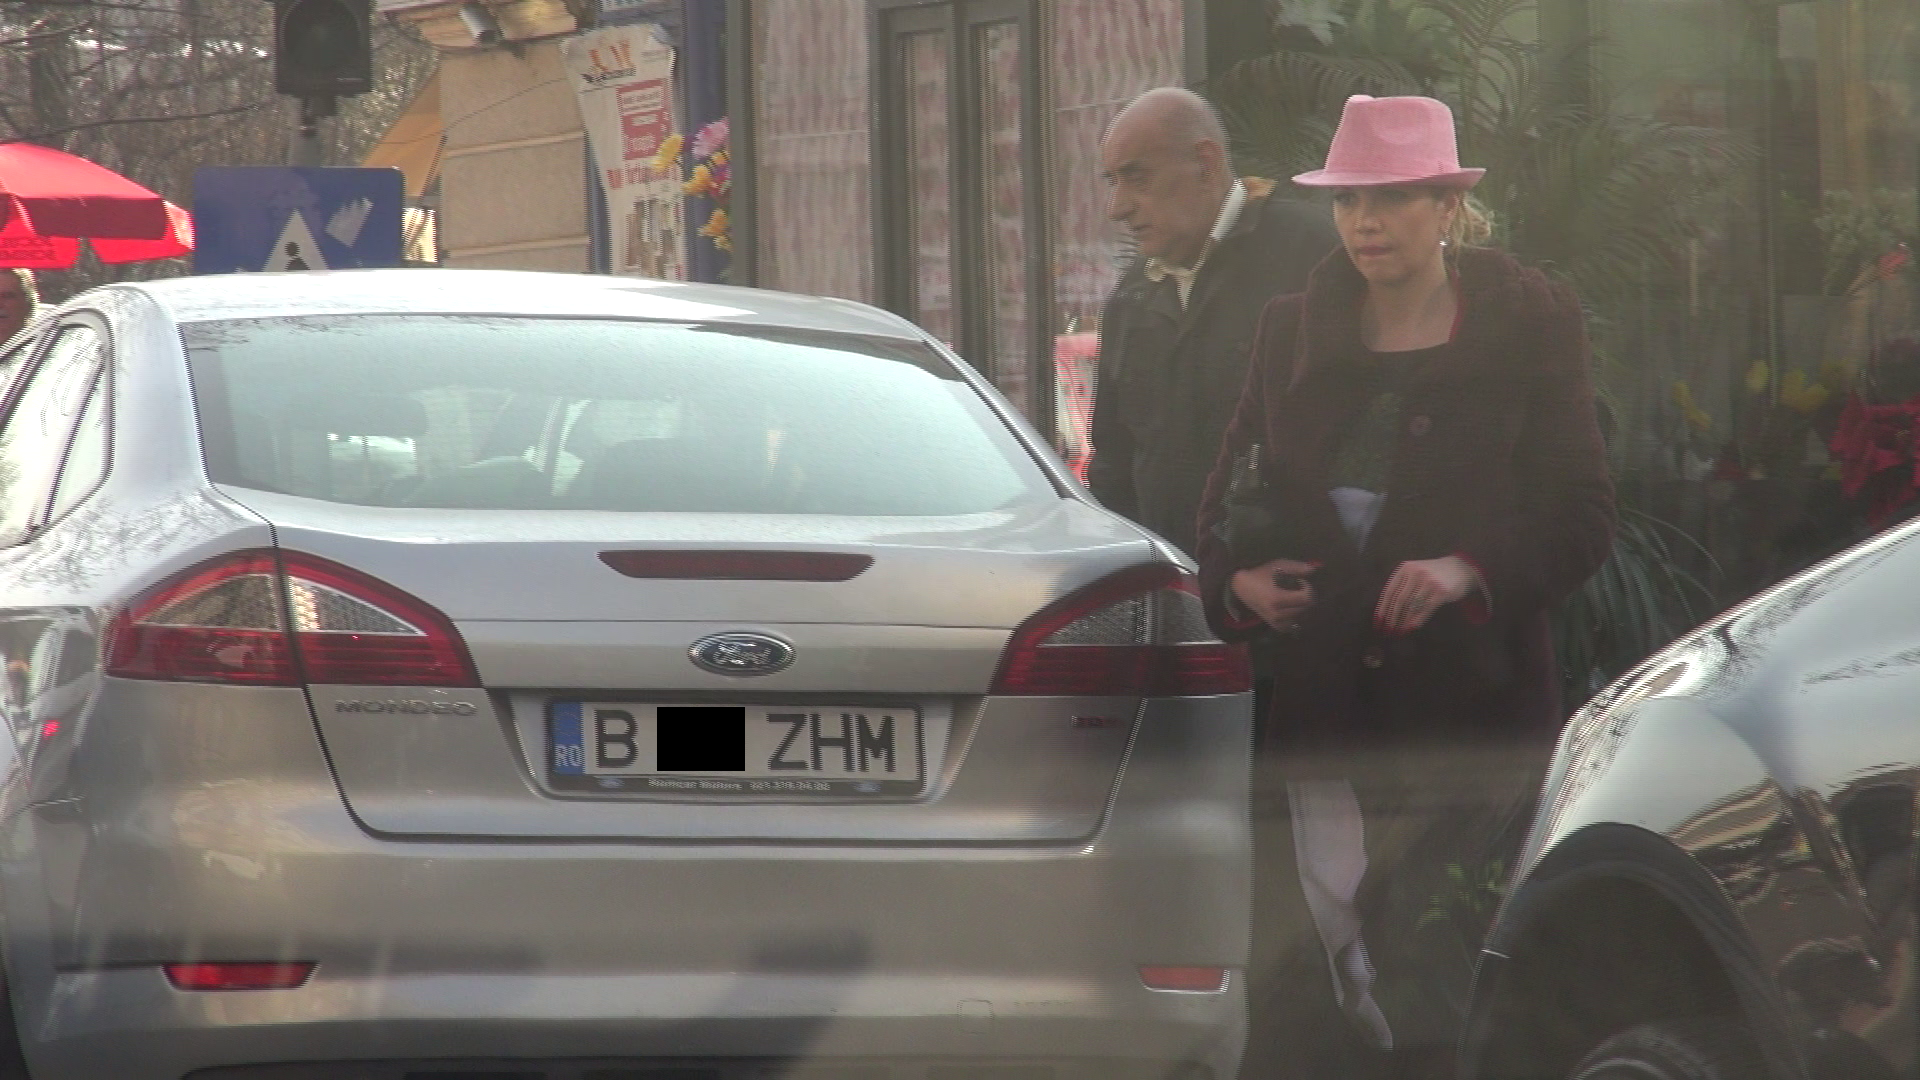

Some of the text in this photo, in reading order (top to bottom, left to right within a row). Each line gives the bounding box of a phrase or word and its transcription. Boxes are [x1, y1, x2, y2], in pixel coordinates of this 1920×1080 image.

[713, 641, 771, 666] Ford
[336, 700, 477, 716] MONDEO
[595, 709, 895, 773] B ZHM
[555, 744, 581, 767] RO
[649, 778, 698, 790] Romcar
[700, 780, 742, 791] Motors
